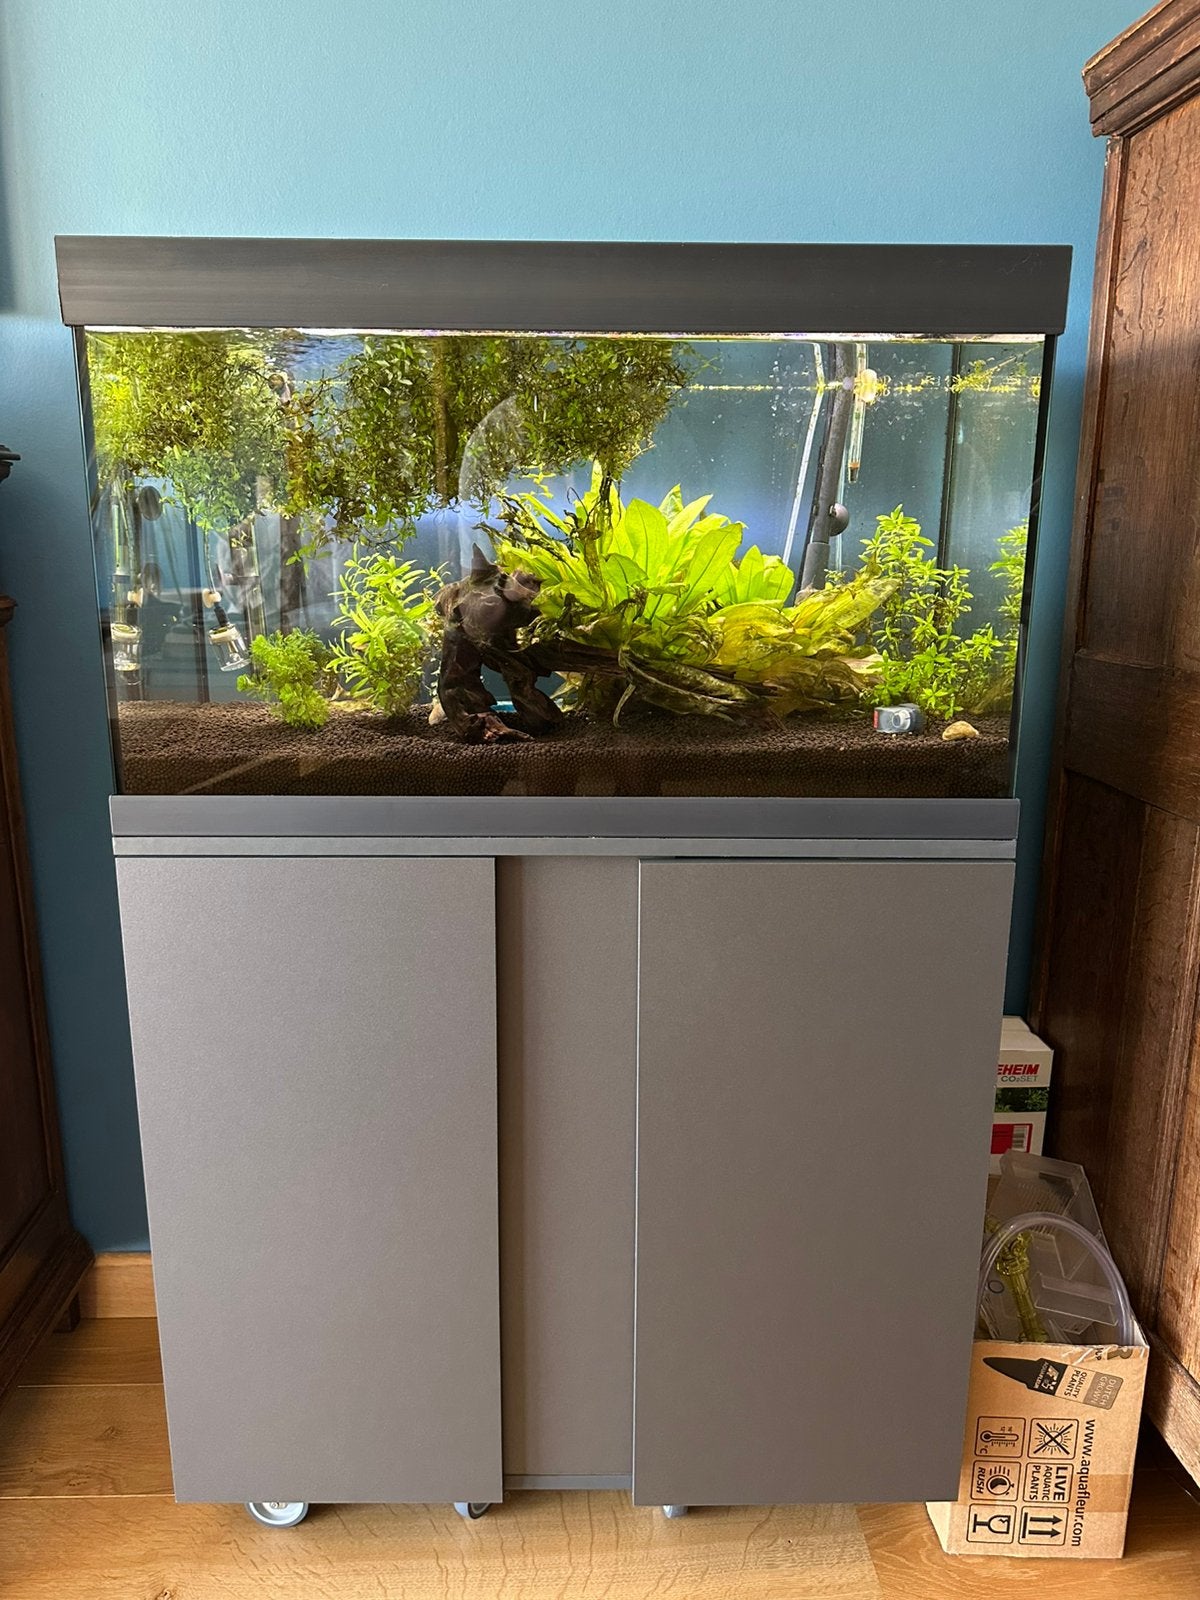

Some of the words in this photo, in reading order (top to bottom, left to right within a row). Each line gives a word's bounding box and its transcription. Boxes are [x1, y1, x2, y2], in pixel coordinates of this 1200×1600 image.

[1064, 1369, 1080, 1397] PLANTS
[1072, 1371, 1088, 1398] QUALITY
[1090, 1376, 1108, 1404] GROWN
[1099, 1379, 1117, 1406] DUTCH
[976, 1466, 986, 1494] RUSH
[1029, 1465, 1041, 1500] PLANTS
[1041, 1466, 1053, 1501] AQUATIC
[1053, 1466, 1068, 1501] LIVE
[1071, 1419, 1096, 1547] www.aquafleur.com
